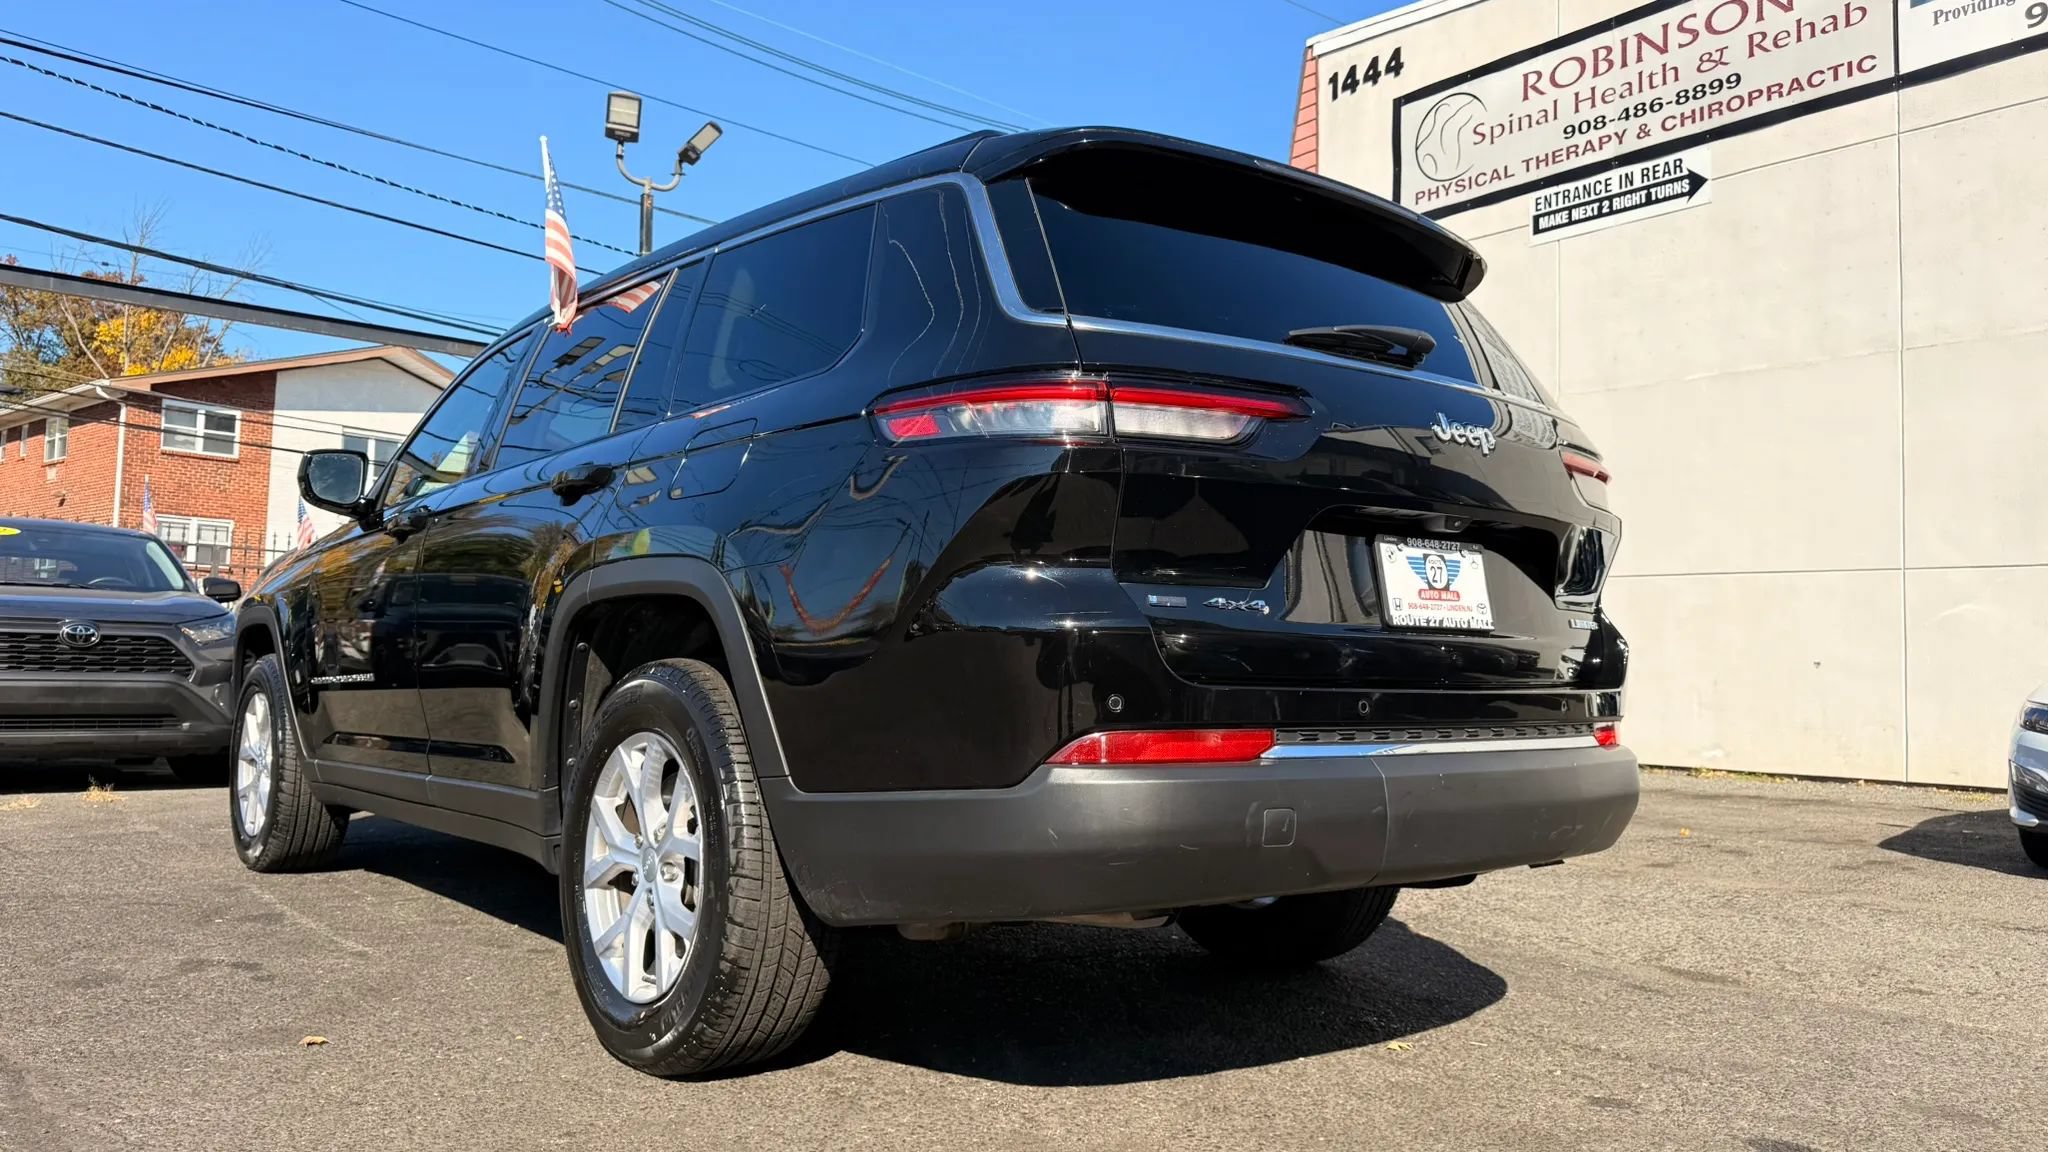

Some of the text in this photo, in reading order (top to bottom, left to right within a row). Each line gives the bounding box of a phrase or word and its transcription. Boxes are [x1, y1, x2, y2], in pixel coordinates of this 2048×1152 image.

[1328, 46, 1404, 102] 1444
[1472, 2, 1868, 146] Spinal Health & Rehab
[1521, 0, 1795, 101] ROBINSON
[1413, 54, 1878, 206] PHYSICAL THERAPY & CHIROPRACTIC
[1562, 72, 1742, 140] 908-486-8899
[1535, 158, 1685, 212] ENTRANCE IN REAR
[1538, 178, 1691, 230] MAKE NEXT 2 RIGHT TURNS
[1431, 411, 1497, 457] Jeep
[1406, 537, 1461, 551] 908-648-2727
[1420, 590, 1459, 600] AUTO MALL
[1429, 565, 1444, 584] 27
[1392, 614, 1429, 626] ROUTE
[1442, 617, 1469, 628] AUTO
